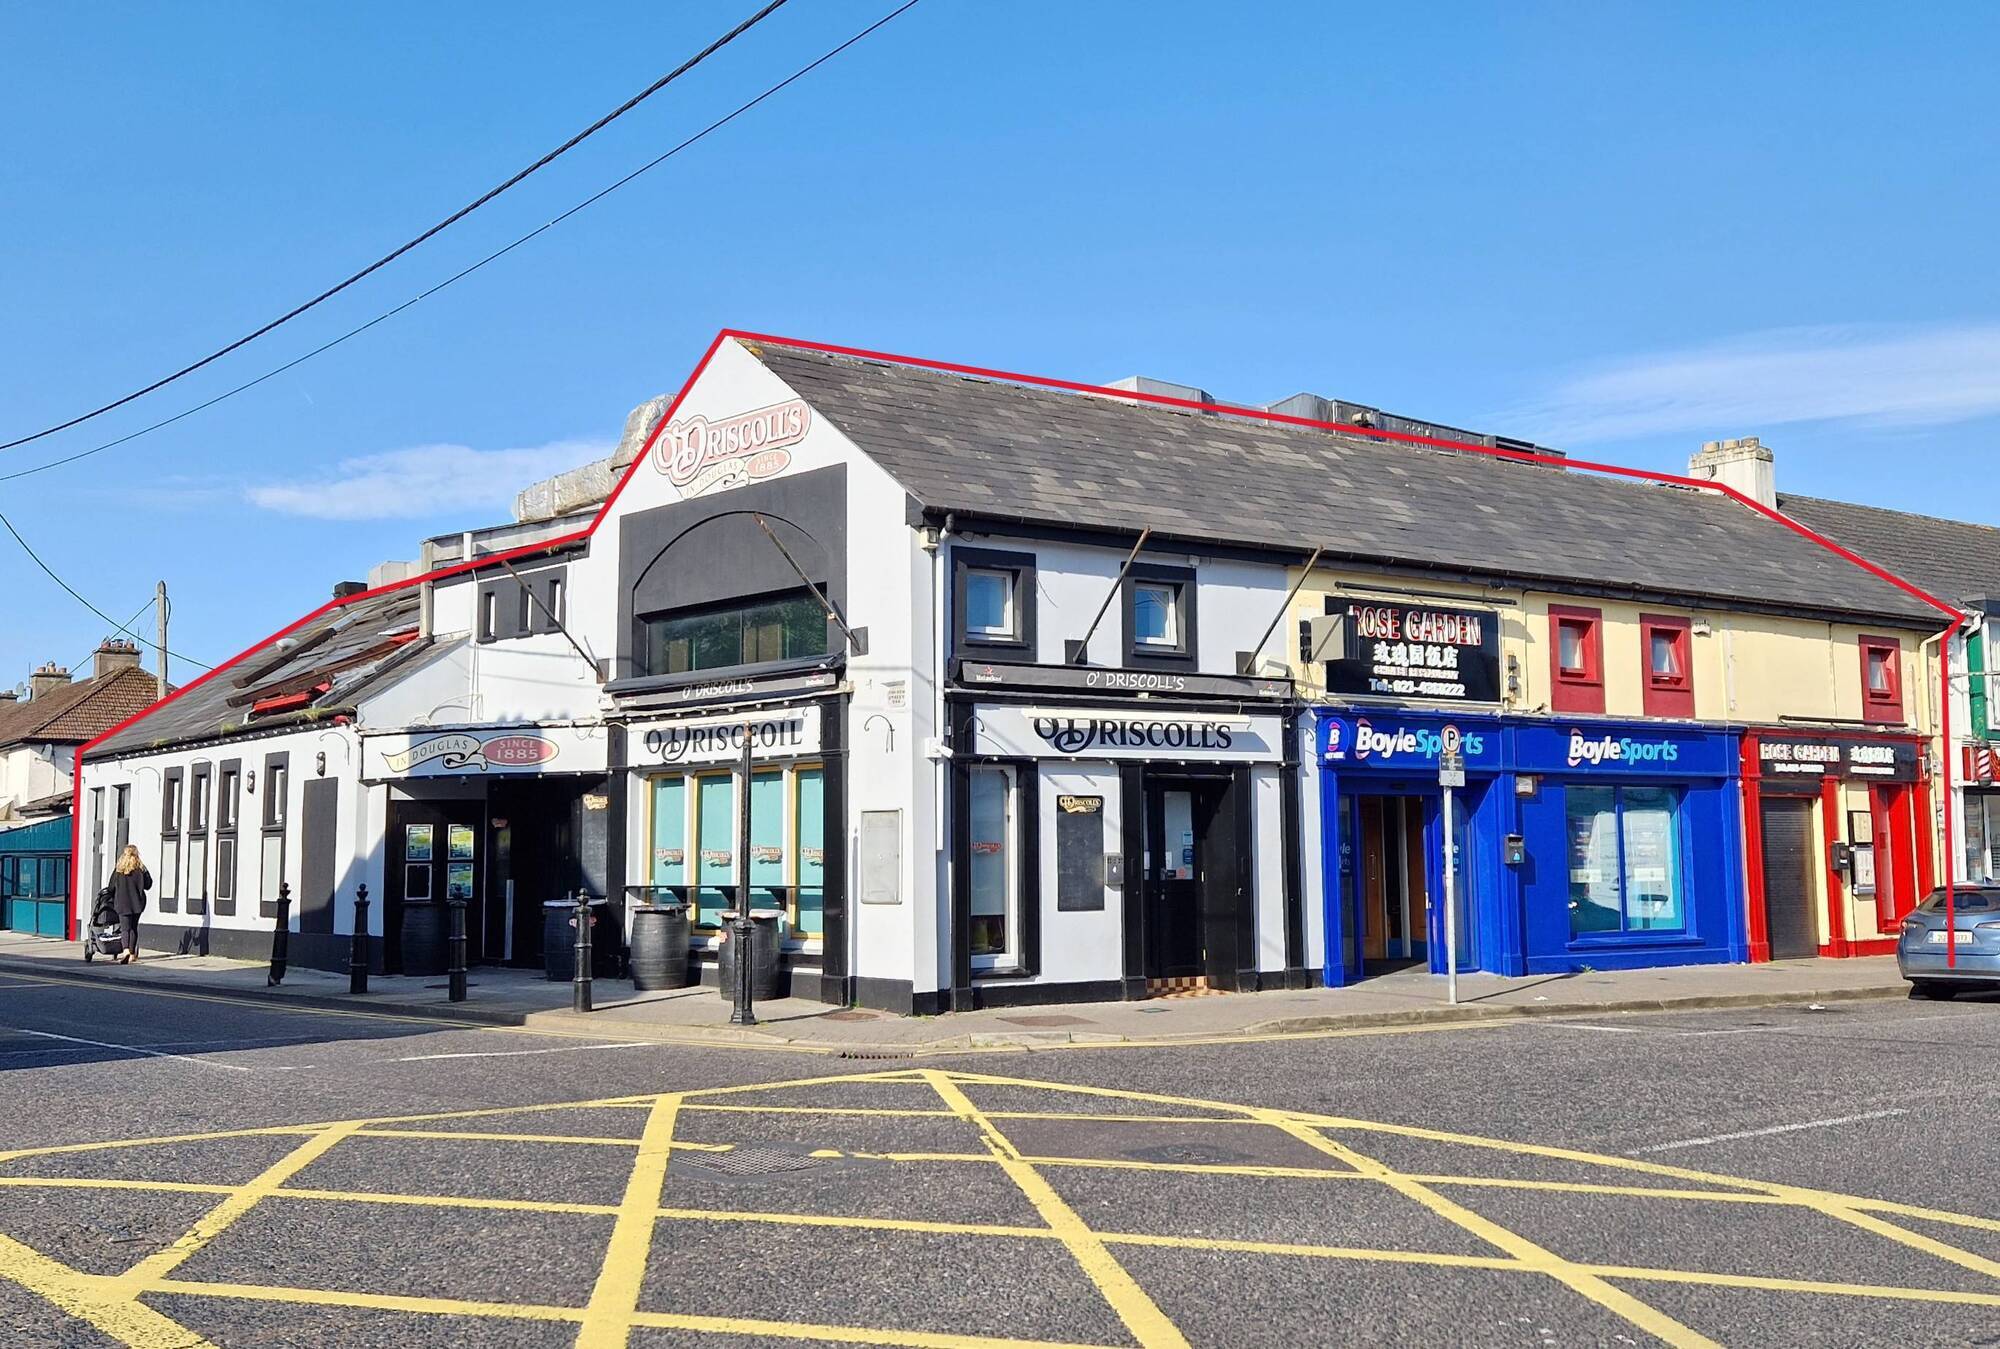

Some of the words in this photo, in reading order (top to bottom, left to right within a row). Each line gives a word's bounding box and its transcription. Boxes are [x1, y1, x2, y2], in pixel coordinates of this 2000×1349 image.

[1406, 611, 1482, 645] GARDEN
[1106, 673, 1185, 691] DRISCOLL'S
[412, 739, 469, 760] DOUGLAS
[496, 748, 538, 759] 1885
[499, 739, 535, 749] SINCE
[1569, 735, 1678, 765] BoyleSports
